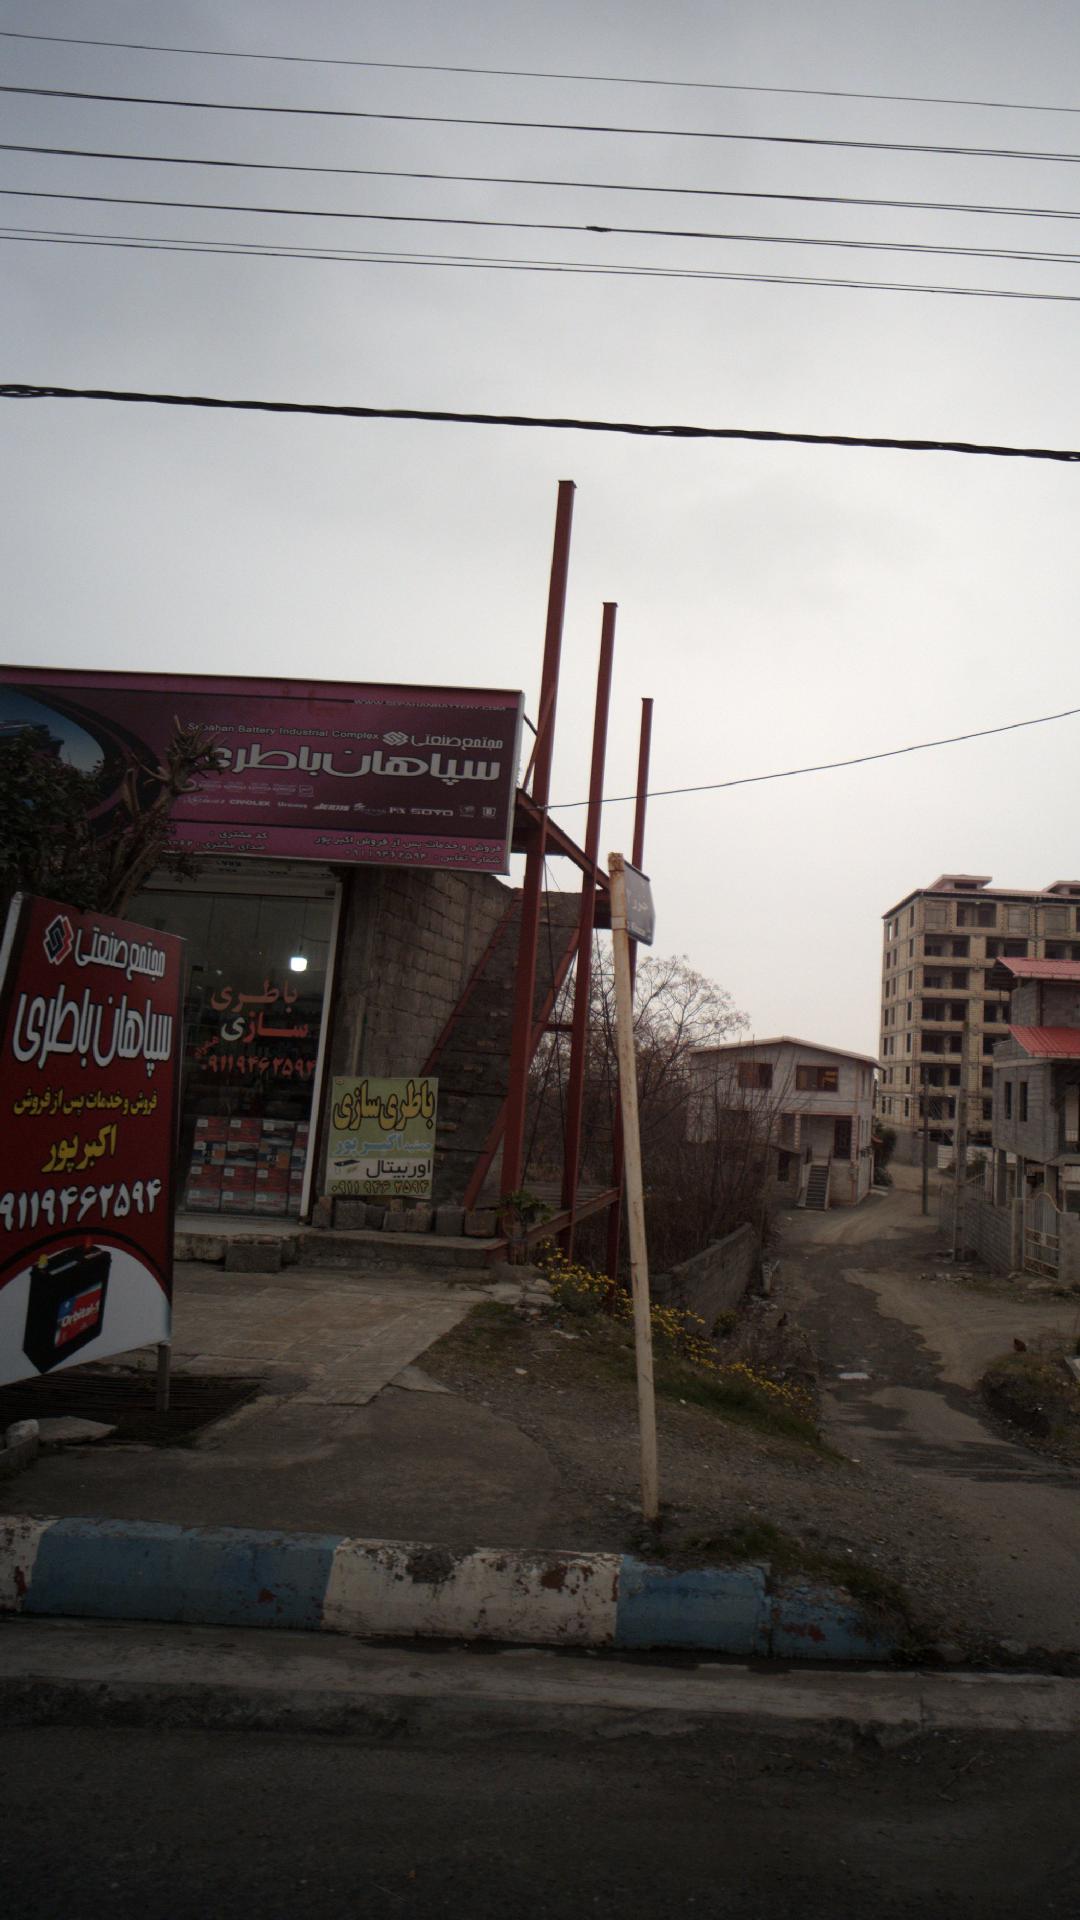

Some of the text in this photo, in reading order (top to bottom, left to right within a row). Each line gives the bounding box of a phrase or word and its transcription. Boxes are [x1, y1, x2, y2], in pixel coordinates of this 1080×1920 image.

[239, 724, 275, 737] Battery
[279, 728, 328, 737] Industrial
[331, 730, 381, 741] Complex
[411, 733, 504, 752] مجتمع صنعتی
[322, 749, 502, 786] سپاهان
[74, 926, 166, 982] مجتمع صنعتی
[210, 976, 298, 1014] باطری
[12, 983, 174, 1079] سپاهان باطری
[220, 1010, 309, 1045] سازی
[12, 1085, 159, 1117] فروش و خدمات پس از فروش
[332, 1079, 436, 1131] باطری سازی
[365, 1159, 431, 1179] اوربیتال
